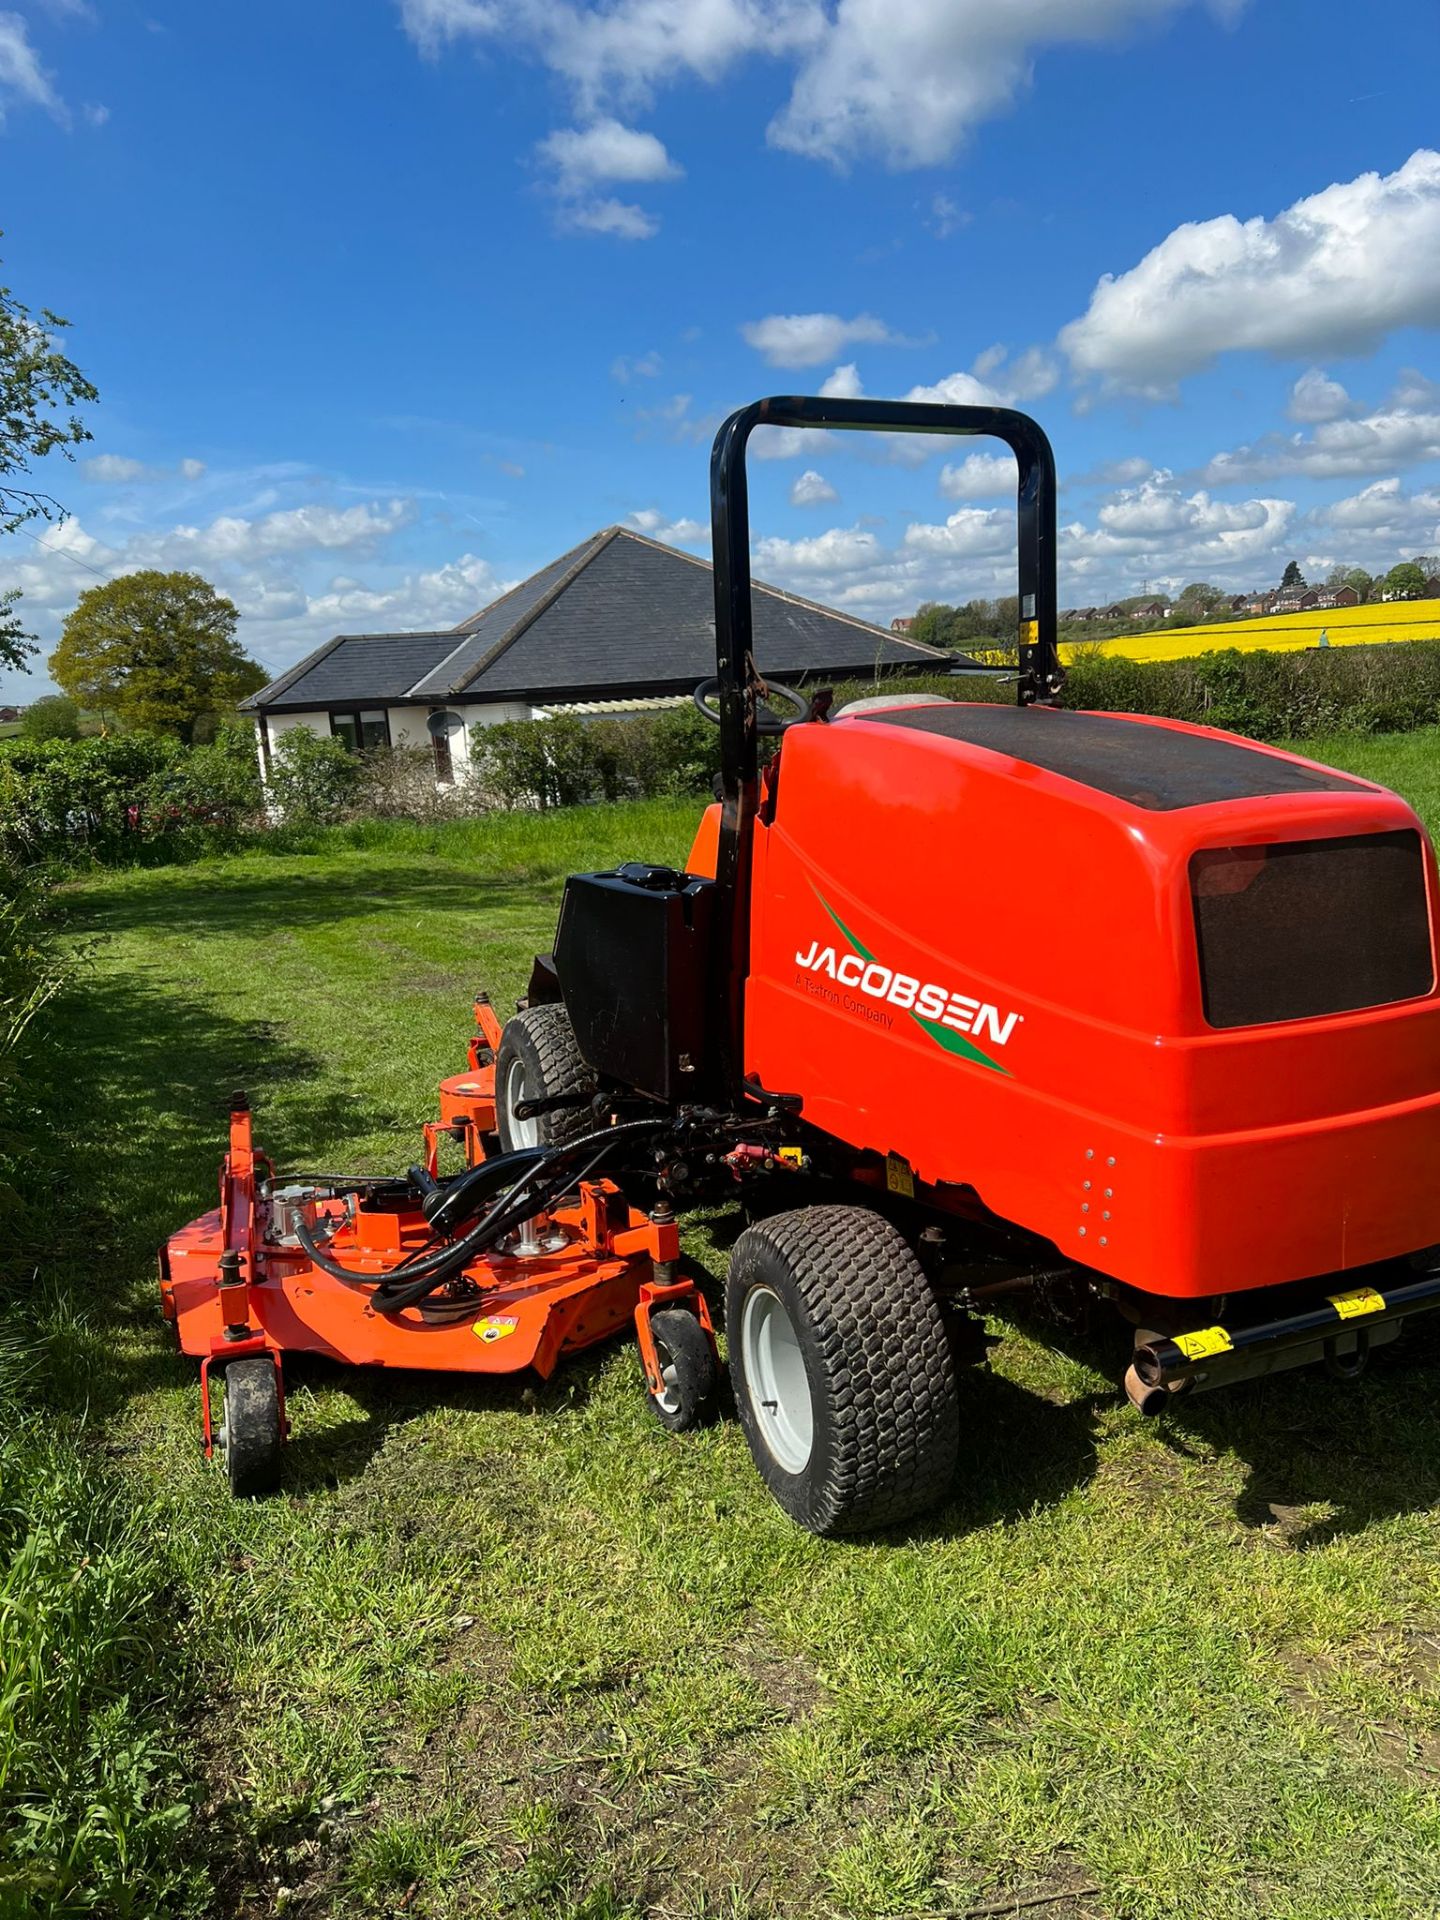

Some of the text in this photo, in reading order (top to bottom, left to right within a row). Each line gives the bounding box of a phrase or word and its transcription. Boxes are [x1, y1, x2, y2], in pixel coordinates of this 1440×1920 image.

[795, 941, 1019, 1046] JACOBSEN
[804, 977, 840, 1005] Textron
[842, 994, 895, 1031] Company
